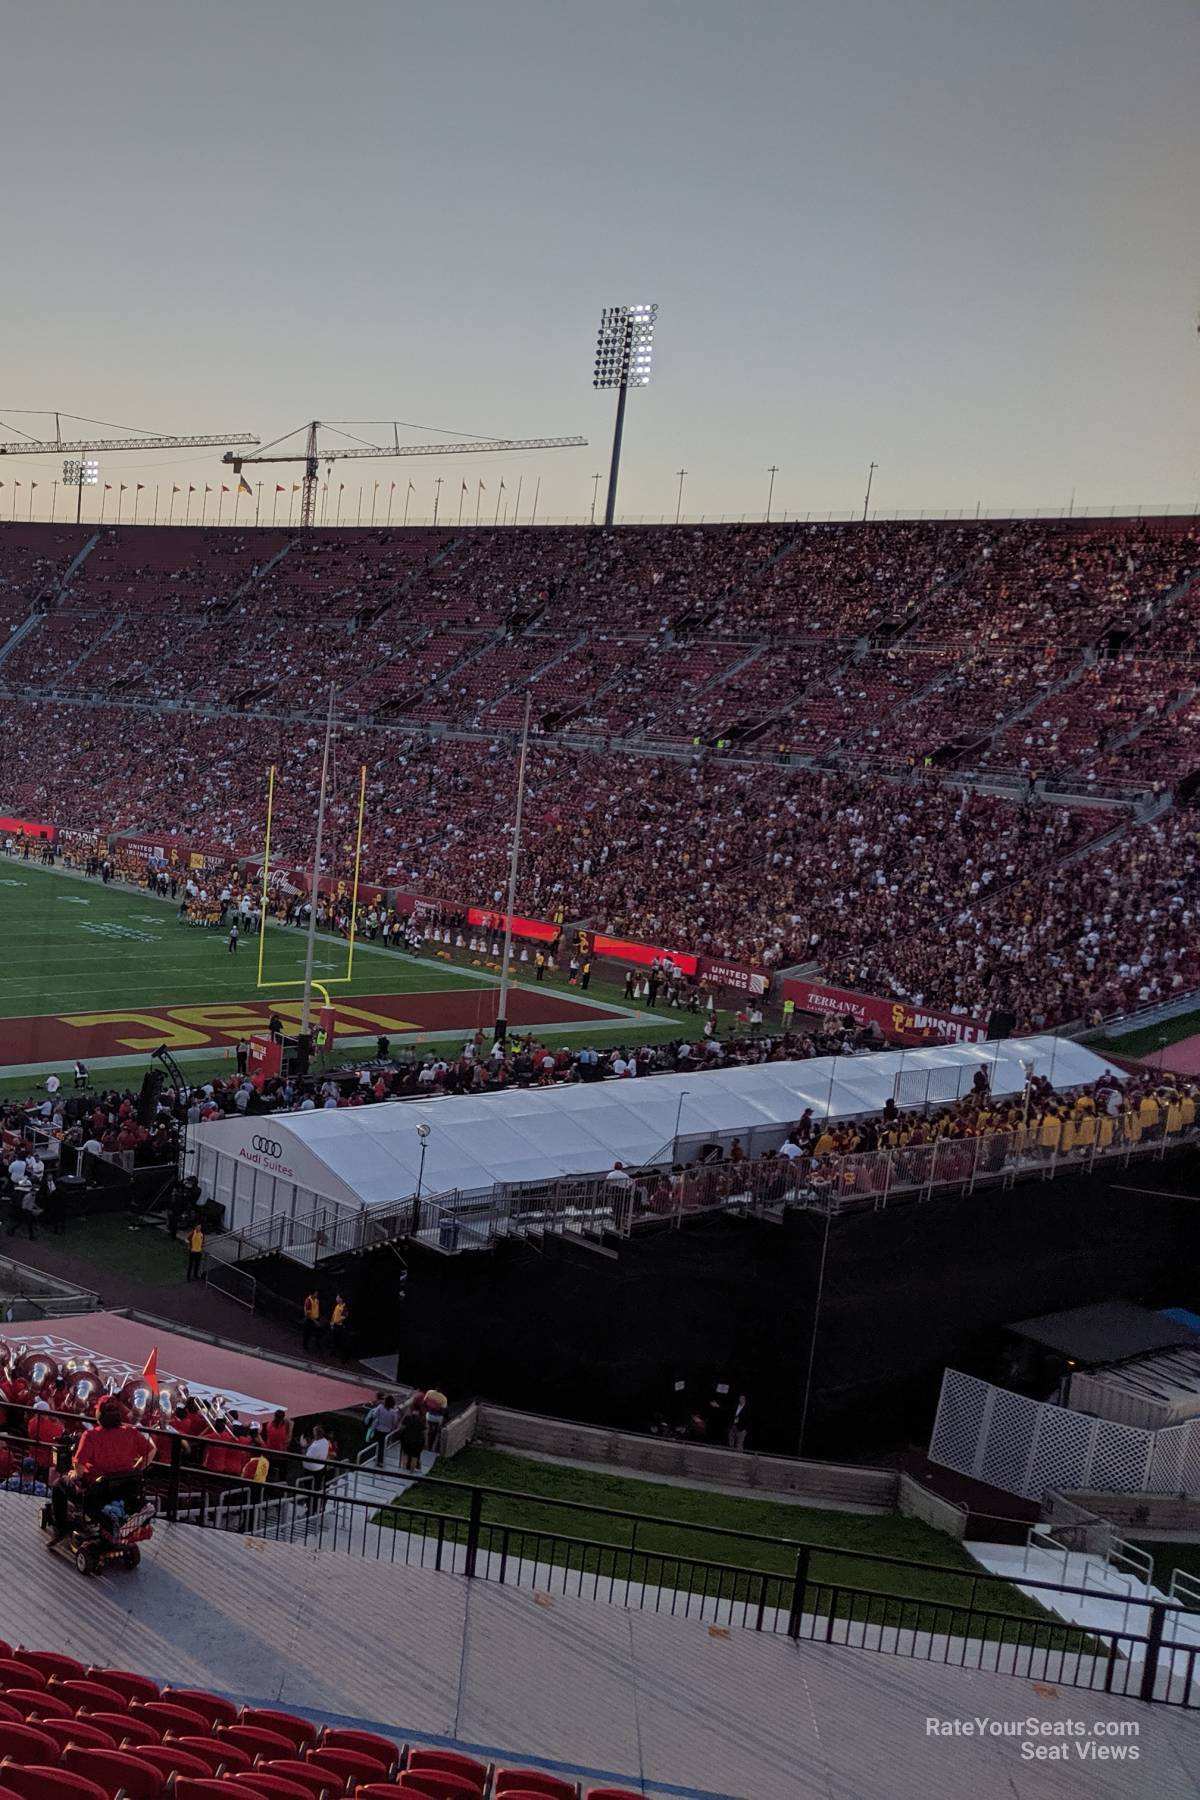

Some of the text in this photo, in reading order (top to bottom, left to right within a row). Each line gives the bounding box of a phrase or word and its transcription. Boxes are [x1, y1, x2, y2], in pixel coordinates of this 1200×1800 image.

[128, 843, 153, 853] UNITED
[711, 965, 749, 981] UNITED
[807, 993, 866, 1016] TERRANEA
[239, 1148, 293, 1176] Audi Suites
